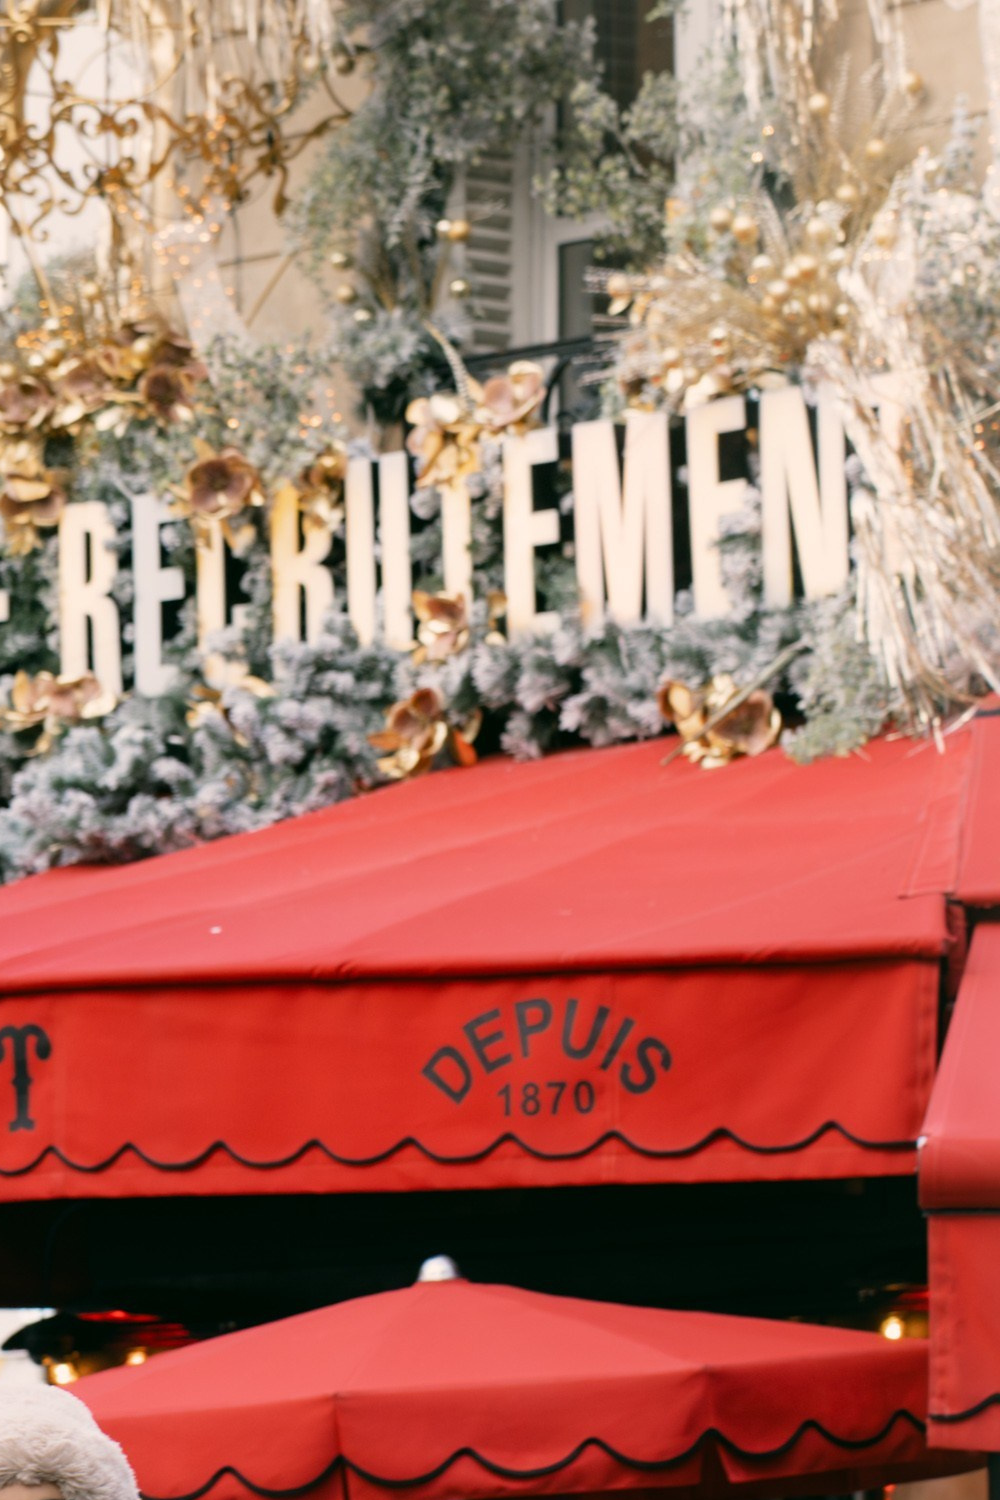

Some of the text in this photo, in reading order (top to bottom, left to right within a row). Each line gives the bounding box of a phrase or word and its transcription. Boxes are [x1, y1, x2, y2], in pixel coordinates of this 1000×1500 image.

[58, 373, 930, 704] RERUEMEN
[421, 998, 673, 1105] DEPUIS
[497, 1080, 596, 1117] 1870
